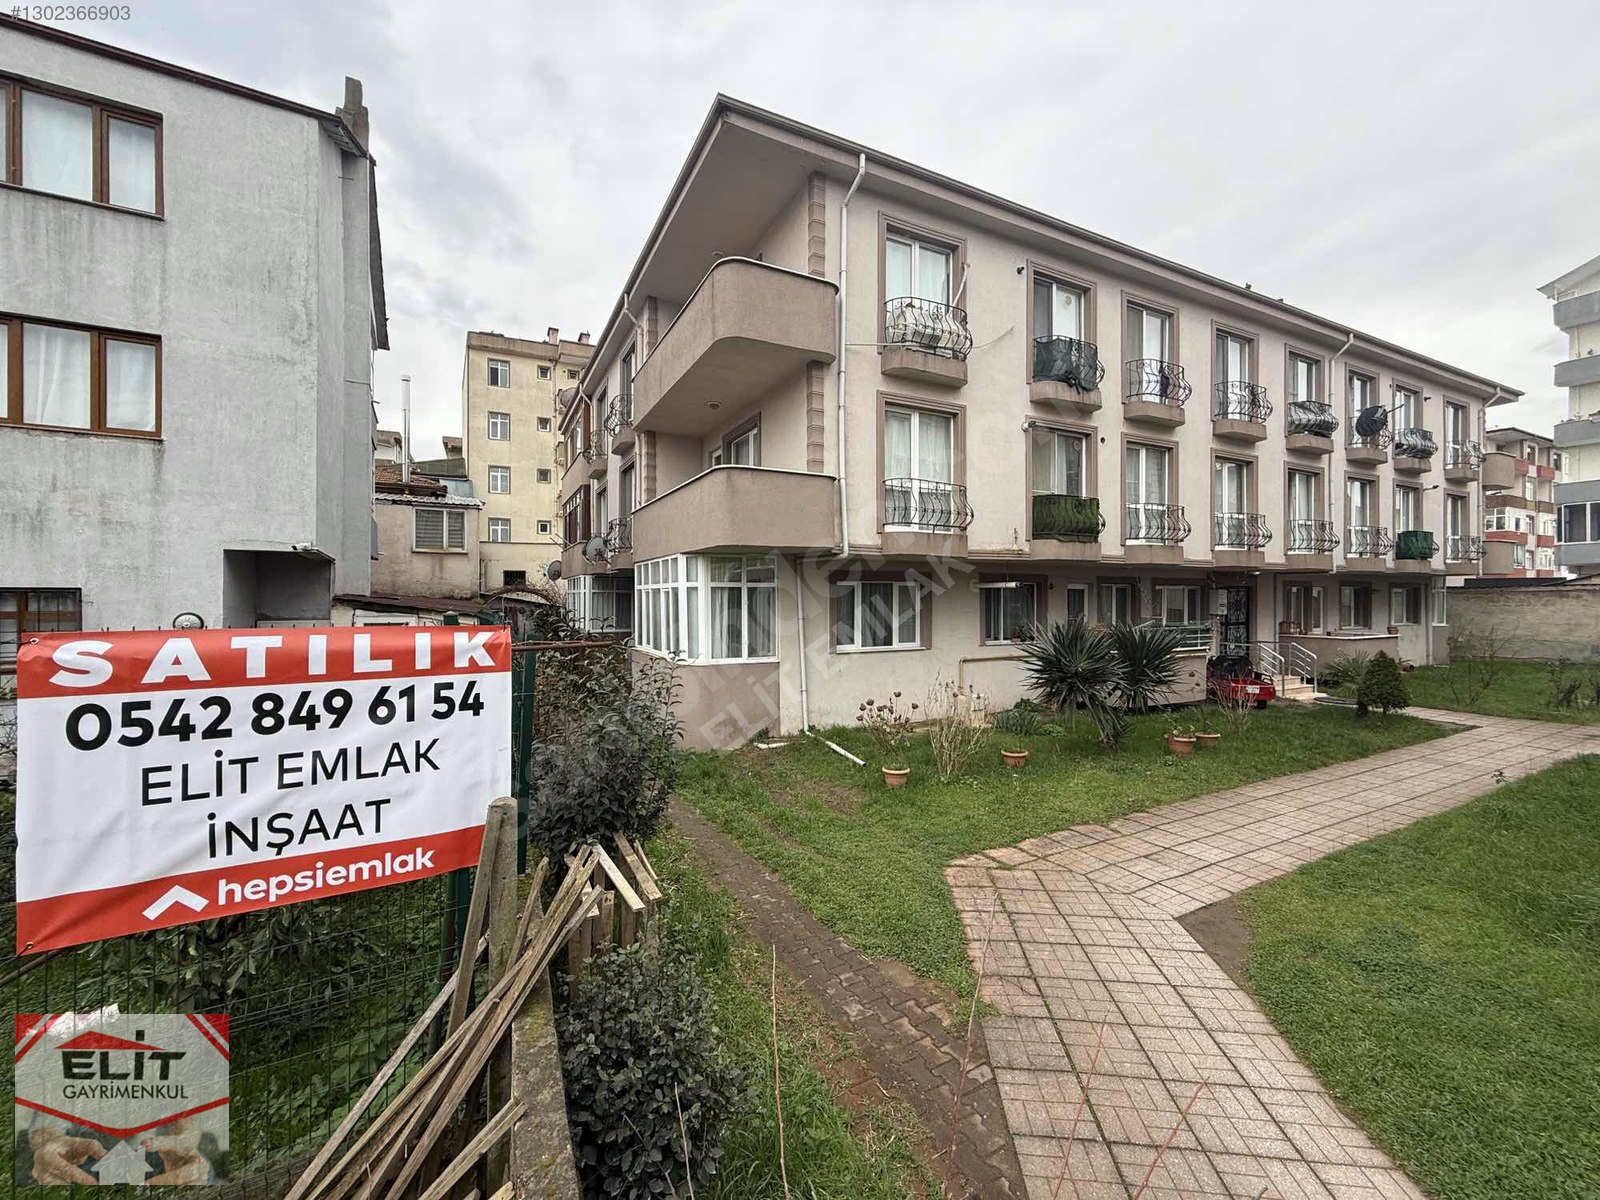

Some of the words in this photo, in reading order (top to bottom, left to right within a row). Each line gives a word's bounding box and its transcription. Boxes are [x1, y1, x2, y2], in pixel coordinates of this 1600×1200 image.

[49, 632, 495, 688] SATILIK
[66, 696, 232, 750] 0542
[251, 688, 353, 735] 849
[368, 685, 416, 726] 61
[432, 680, 484, 721] 54
[141, 749, 259, 806] ELİT
[277, 738, 440, 790] EMLAK
[208, 799, 391, 858] İNŞAAT
[218, 847, 435, 907] hepsiemlak
